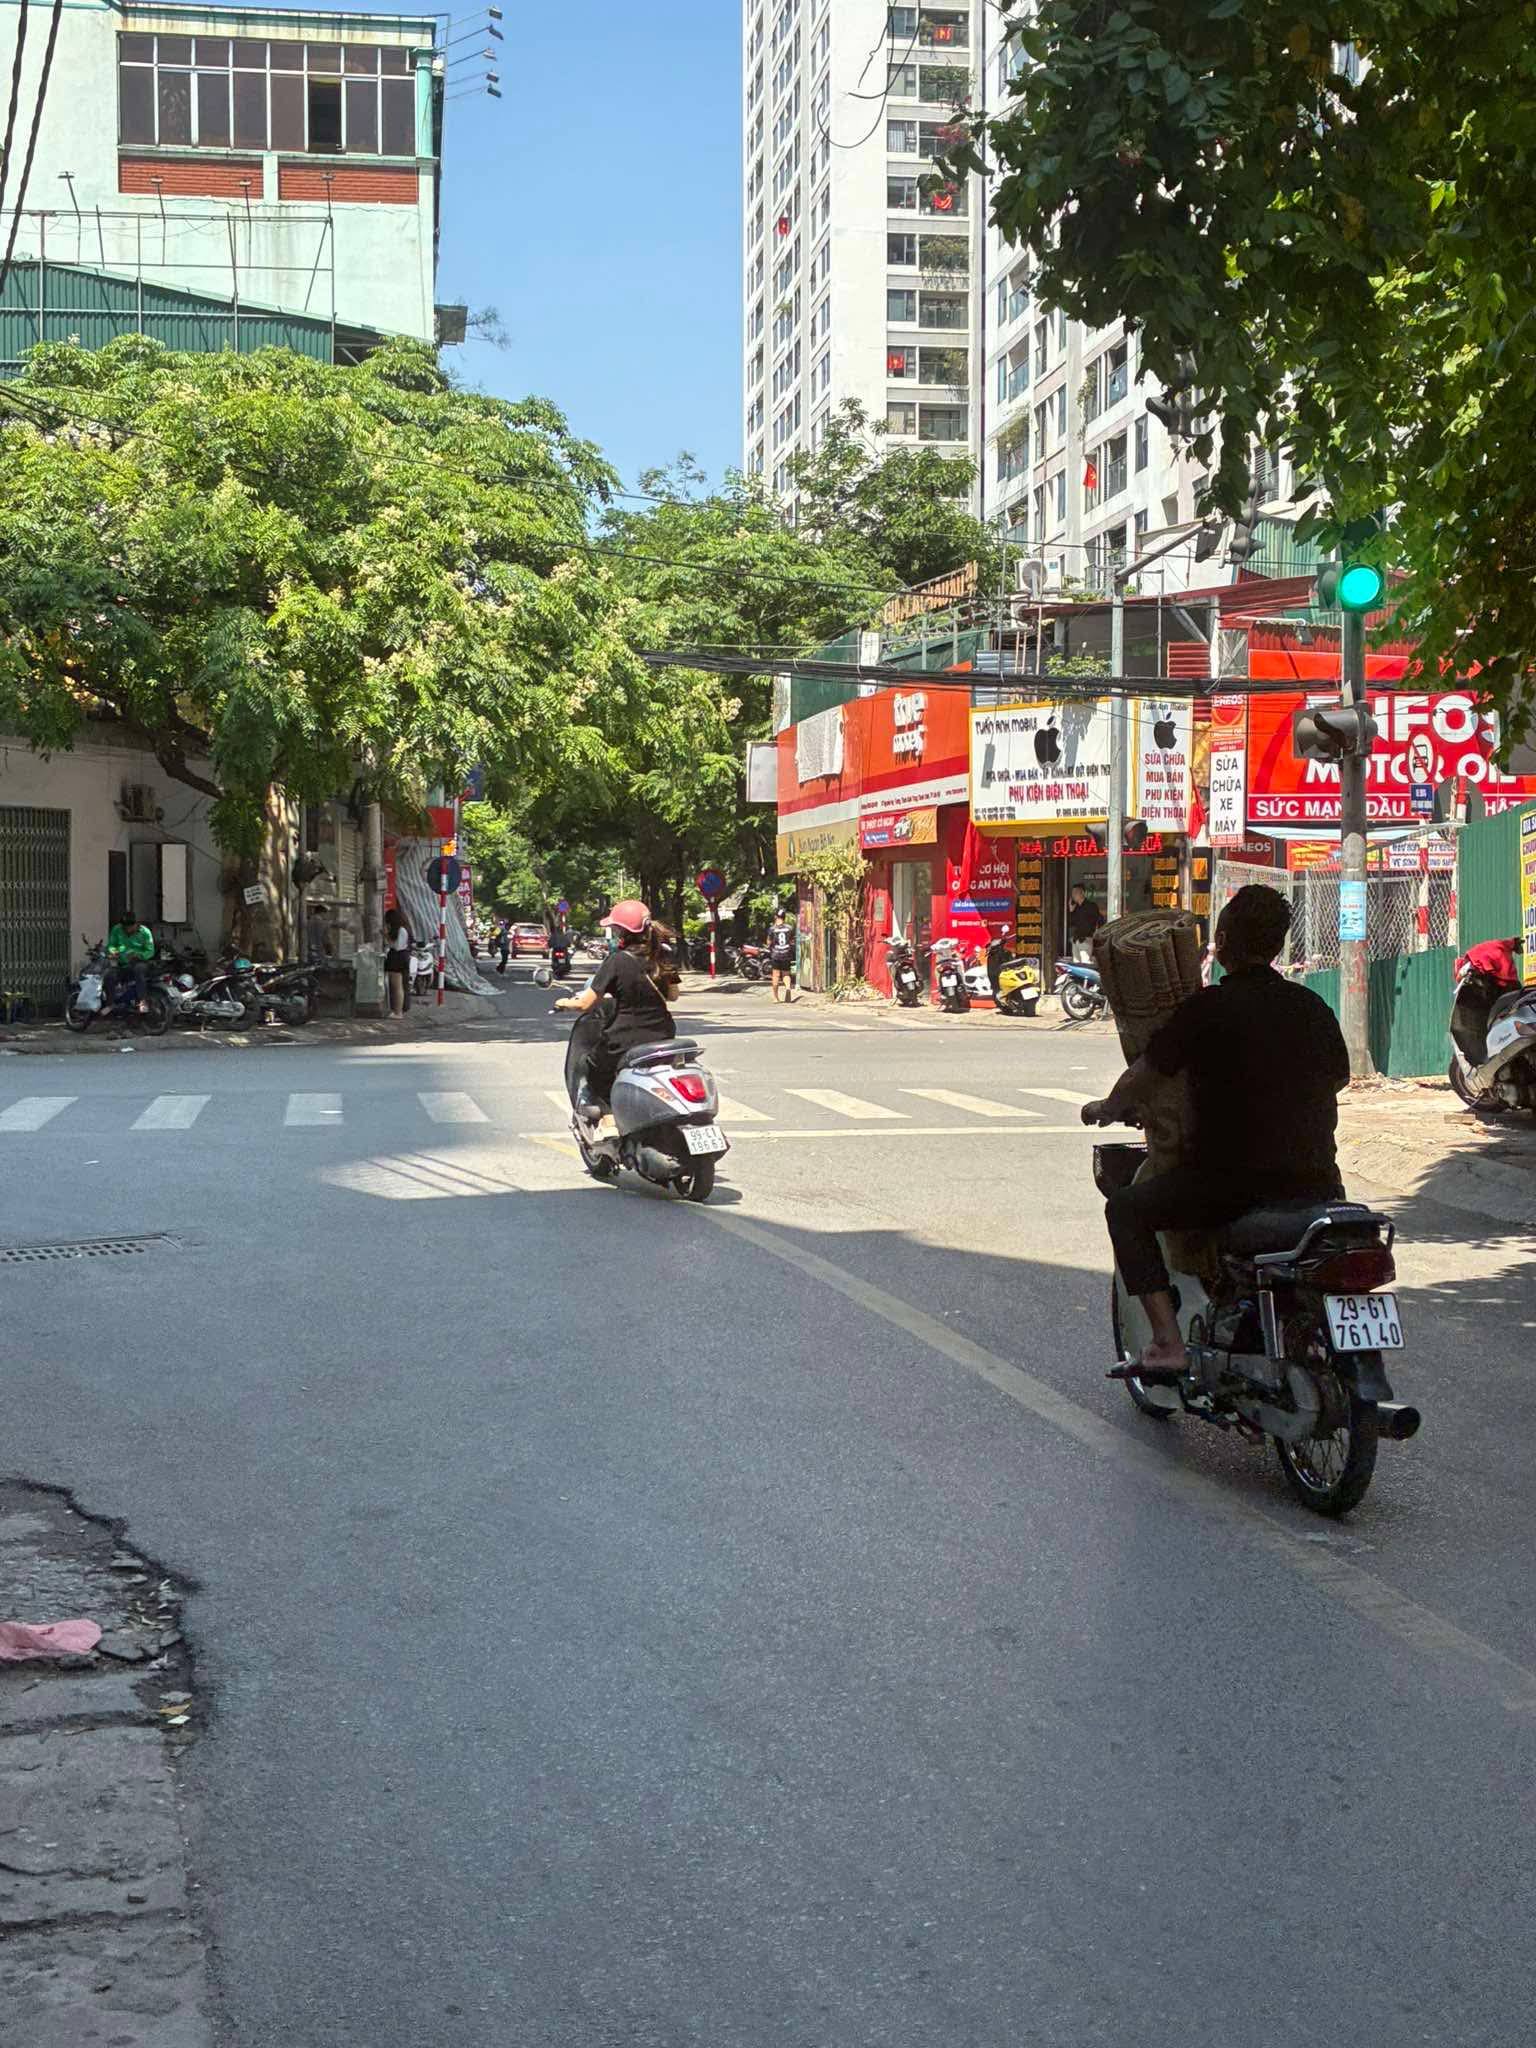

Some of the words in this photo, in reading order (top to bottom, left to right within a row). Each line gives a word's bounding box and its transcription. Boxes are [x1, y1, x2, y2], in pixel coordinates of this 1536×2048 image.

[1216, 754, 1238, 772] SỬA
[1146, 771, 1164, 783] MUA
[1167, 769, 1184, 783] BÁN
[1212, 775, 1242, 793] CHỮA
[1009, 785, 1024, 805] PHỤ
[1026, 783, 1044, 804] KIỆN
[1046, 781, 1063, 804] ĐIỆN
[1066, 783, 1089, 802] THOẠI
[1219, 798, 1233, 811] XE
[1255, 796, 1300, 817] SỨC
[1366, 795, 1405, 817] DẦU
[1215, 816, 1237, 833] MÁY
[993, 861, 1010, 876] HỘI
[977, 879, 991, 889] AN
[992, 877, 1012, 889] TÂM
[778, 932, 786, 946] 8
[1336, 1296, 1388, 1321] 29-G1
[1336, 1322, 1400, 1348] 761.40
